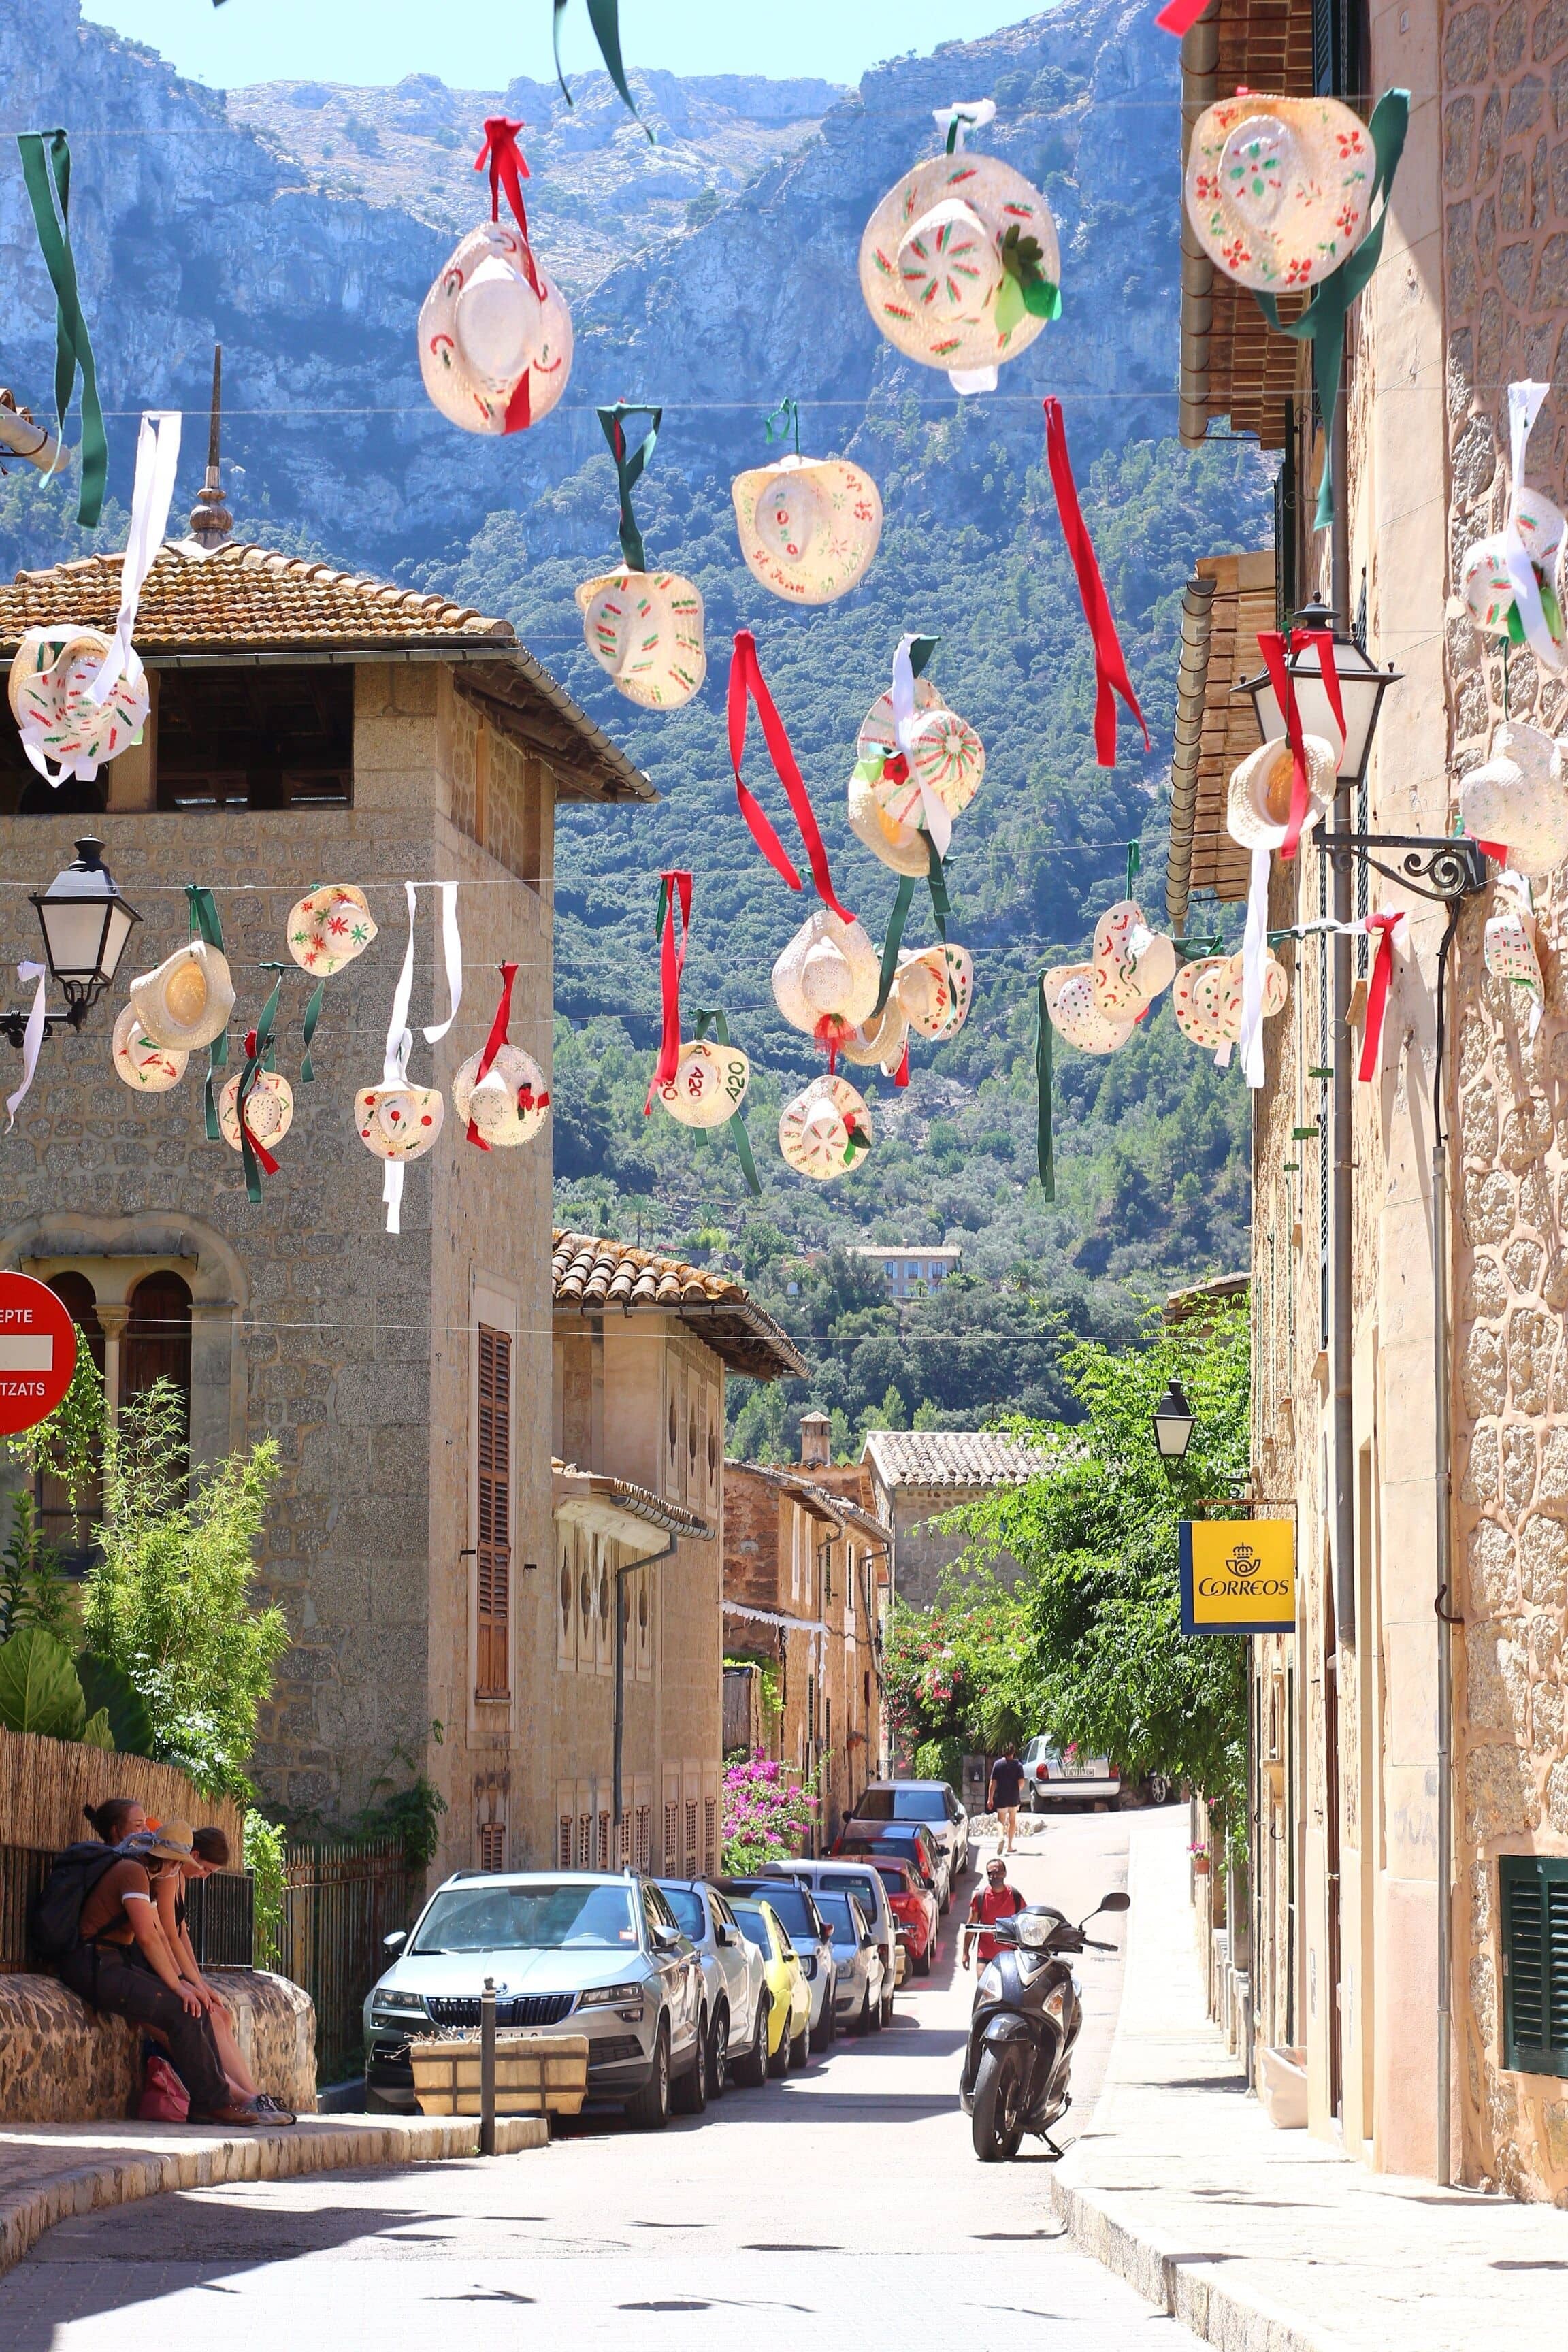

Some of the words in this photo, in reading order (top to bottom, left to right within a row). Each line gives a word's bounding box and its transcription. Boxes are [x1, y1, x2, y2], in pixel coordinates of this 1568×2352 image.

[689, 1066, 704, 1096] A20
[725, 1061, 745, 1103] A20
[1198, 1578, 1289, 1597] CORREOS
